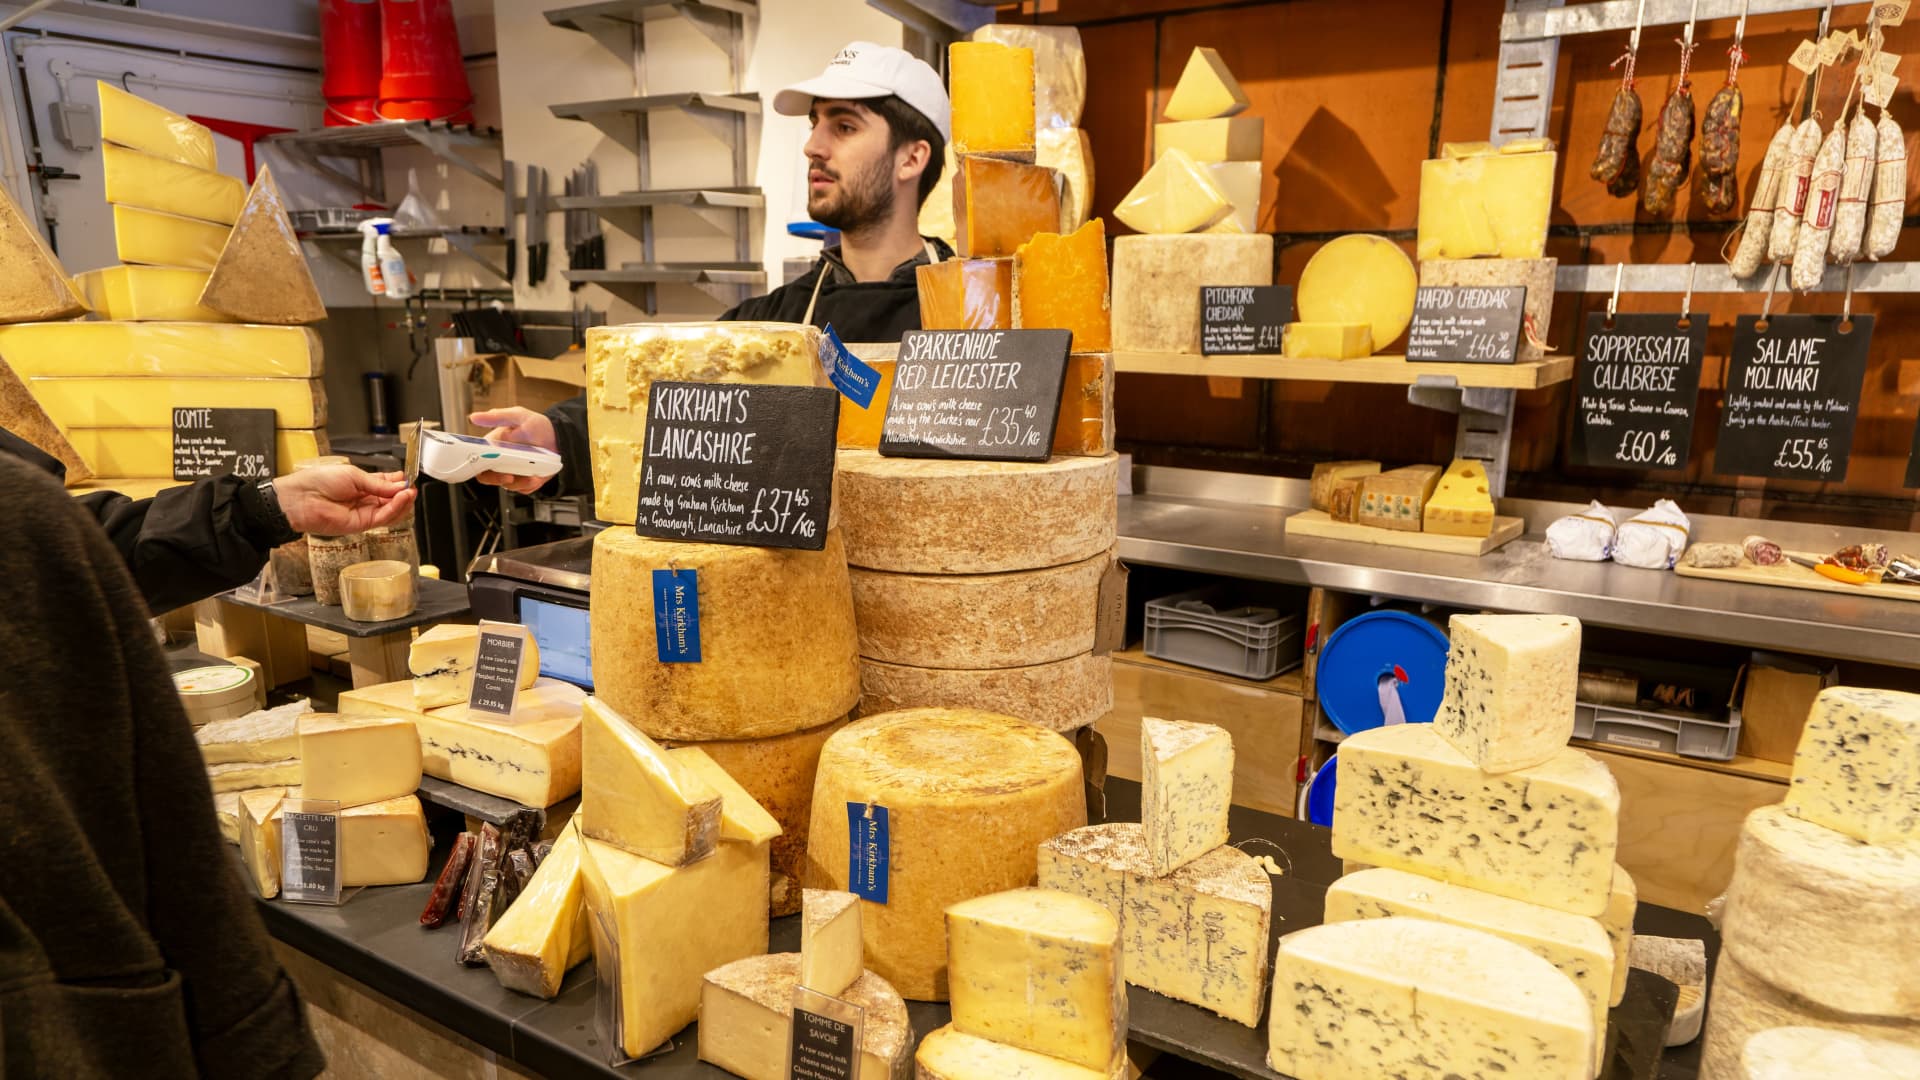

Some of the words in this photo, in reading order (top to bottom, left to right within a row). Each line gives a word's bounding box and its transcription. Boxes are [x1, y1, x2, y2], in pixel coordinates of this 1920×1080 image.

[1205, 287, 1255, 304] PITCHFORK
[1416, 289, 1454, 309] HAFOD
[1457, 288, 1511, 309] CHEDDAR
[1205, 306, 1245, 321] CHEDDAR
[904, 332, 1005, 362] SPARKENHOE
[1466, 334, 1496, 359] £46
[1587, 334, 1690, 364] SOPPRESSATA
[1752, 338, 1826, 365] SALAME
[837, 356, 871, 388] Kirkham's
[896, 363, 927, 391] RED
[931, 361, 1022, 390] LEICESTER
[1593, 364, 1680, 392] CALABRESE
[1744, 365, 1820, 392] MOLINARI
[654, 386, 750, 424] KIRKHAM'S
[891, 395, 900, 412] A
[899, 401, 914, 412] raw
[917, 399, 936, 413] cow's
[938, 398, 957, 411] milk
[958, 397, 983, 412] cheese
[1582, 396, 1598, 409] Made
[1599, 397, 1607, 414] by
[1728, 393, 1751, 412] Lightly
[1774, 397, 1785, 409] and
[1786, 398, 1801, 410] made
[1803, 399, 1812, 414] by
[1813, 399, 1823, 411] the
[887, 412, 905, 426] made
[906, 413, 918, 432] by
[919, 412, 931, 426] the
[933, 411, 963, 427] Clarke's
[965, 417, 980, 429] near
[978, 406, 1023, 447] £35
[1025, 405, 1037, 420] 40
[1726, 411, 1746, 429] family
[1747, 417, 1755, 425] on
[1756, 414, 1767, 425] the
[649, 426, 757, 465] LANCASHIRE
[1616, 429, 1656, 462] £60
[1818, 438, 1828, 450] 65
[232, 455, 257, 477] £38
[645, 465, 653, 486] A
[657, 474, 677, 488] raw,
[681, 473, 702, 489] cow's
[704, 471, 722, 490] milk
[723, 472, 750, 493] cheese
[640, 491, 661, 506] made
[663, 492, 674, 515] by
[677, 494, 708, 512] Graham
[711, 497, 745, 515] Kirkham
[747, 488, 793, 534] £37
[639, 513, 648, 526] in
[698, 517, 744, 536] Lancashire.
[675, 585, 685, 605] Mrs
[676, 607, 688, 654] Kirkham's
[486, 638, 515, 649] MORBIER
[497, 701, 504, 710] kg
[303, 824, 319, 832] CRU
[320, 815, 336, 823] LAIT
[868, 820, 878, 840] Mrs
[867, 842, 878, 891] Kirkham's
[803, 1012, 833, 1029] TOMME
[834, 1022, 846, 1033] DE
[809, 1028, 839, 1045] SAVOIE
[800, 1055, 820, 1067] cheese
[820, 1063, 836, 1073] made
[837, 1067, 845, 1077] by
[805, 1047, 817, 1055] raw
[817, 1050, 834, 1061] cow's
[834, 1055, 848, 1064] milk
[793, 1064, 813, 1077] Claude
